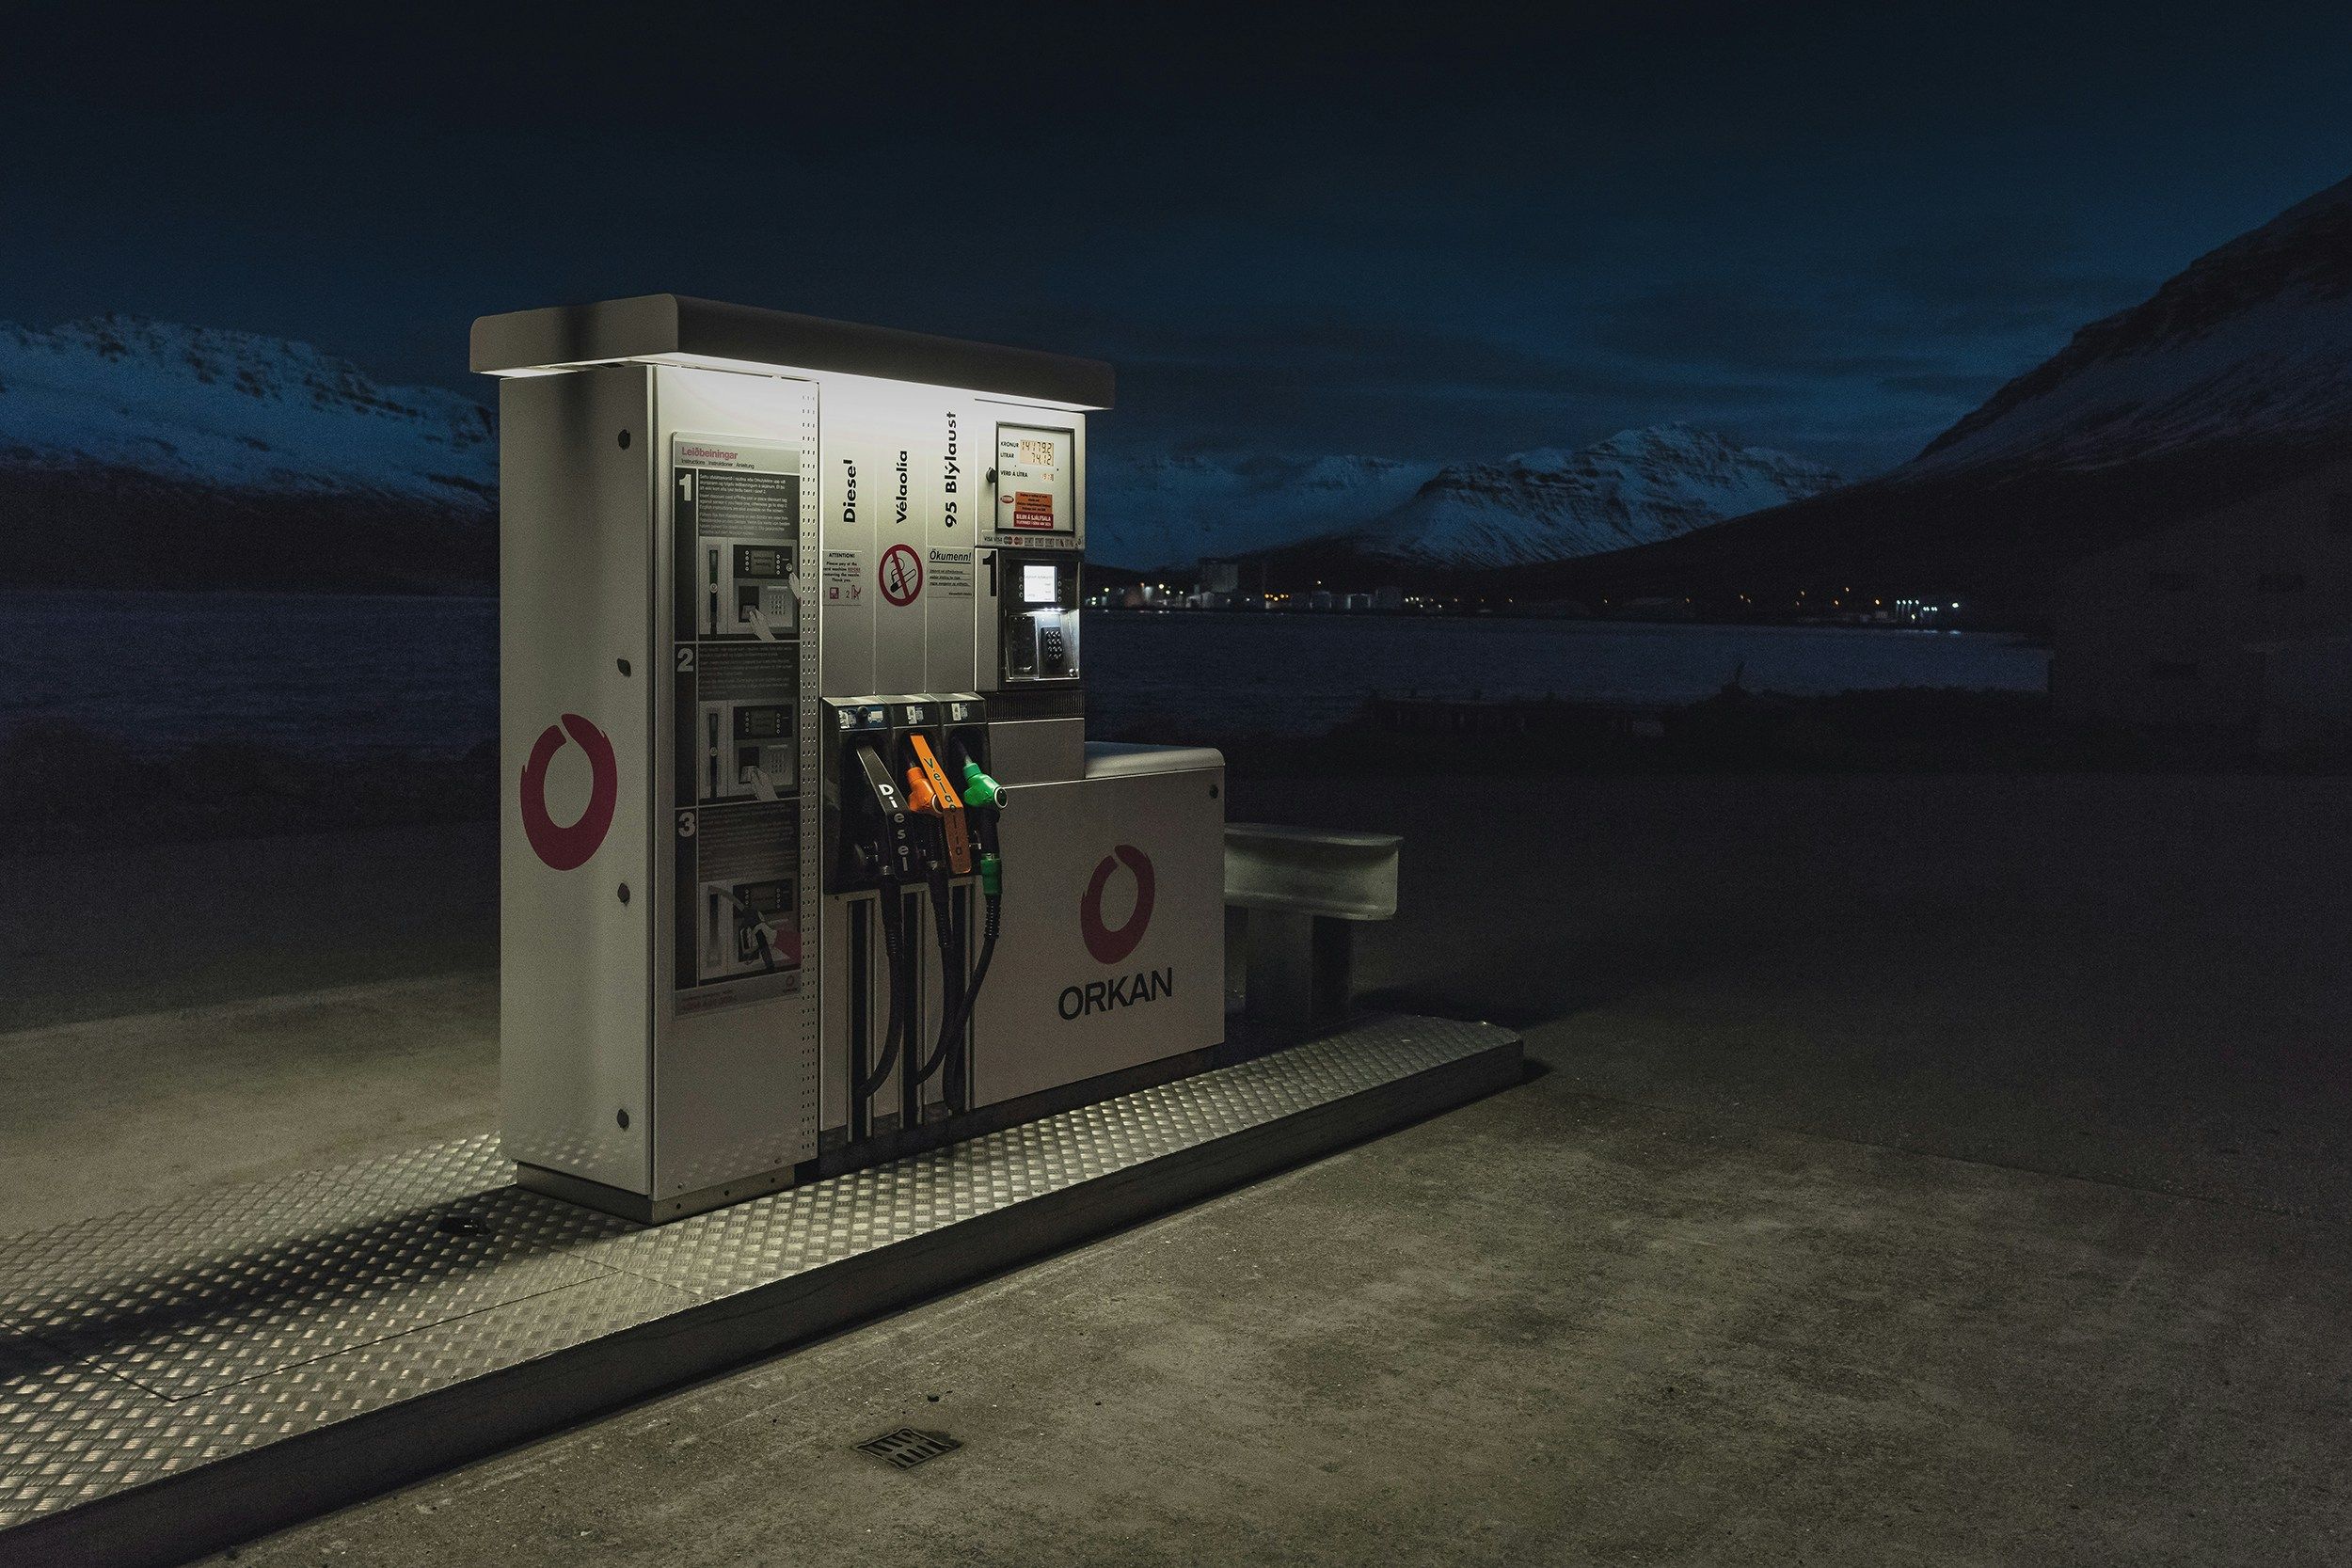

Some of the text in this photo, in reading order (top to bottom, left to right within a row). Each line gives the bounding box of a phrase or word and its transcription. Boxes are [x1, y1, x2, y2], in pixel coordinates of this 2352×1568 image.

[682, 447, 739, 460] Leiðbeiningar
[945, 411, 961, 528] 95 Blýlaust
[679, 474, 691, 501] 1
[896, 451, 908, 524] Vélaolía
[930, 548, 972, 562] Ökumenn!
[983, 550, 996, 596] 1
[676, 648, 694, 673] 2
[677, 812, 695, 837] 3
[1058, 967, 1172, 1021] ORKAN
